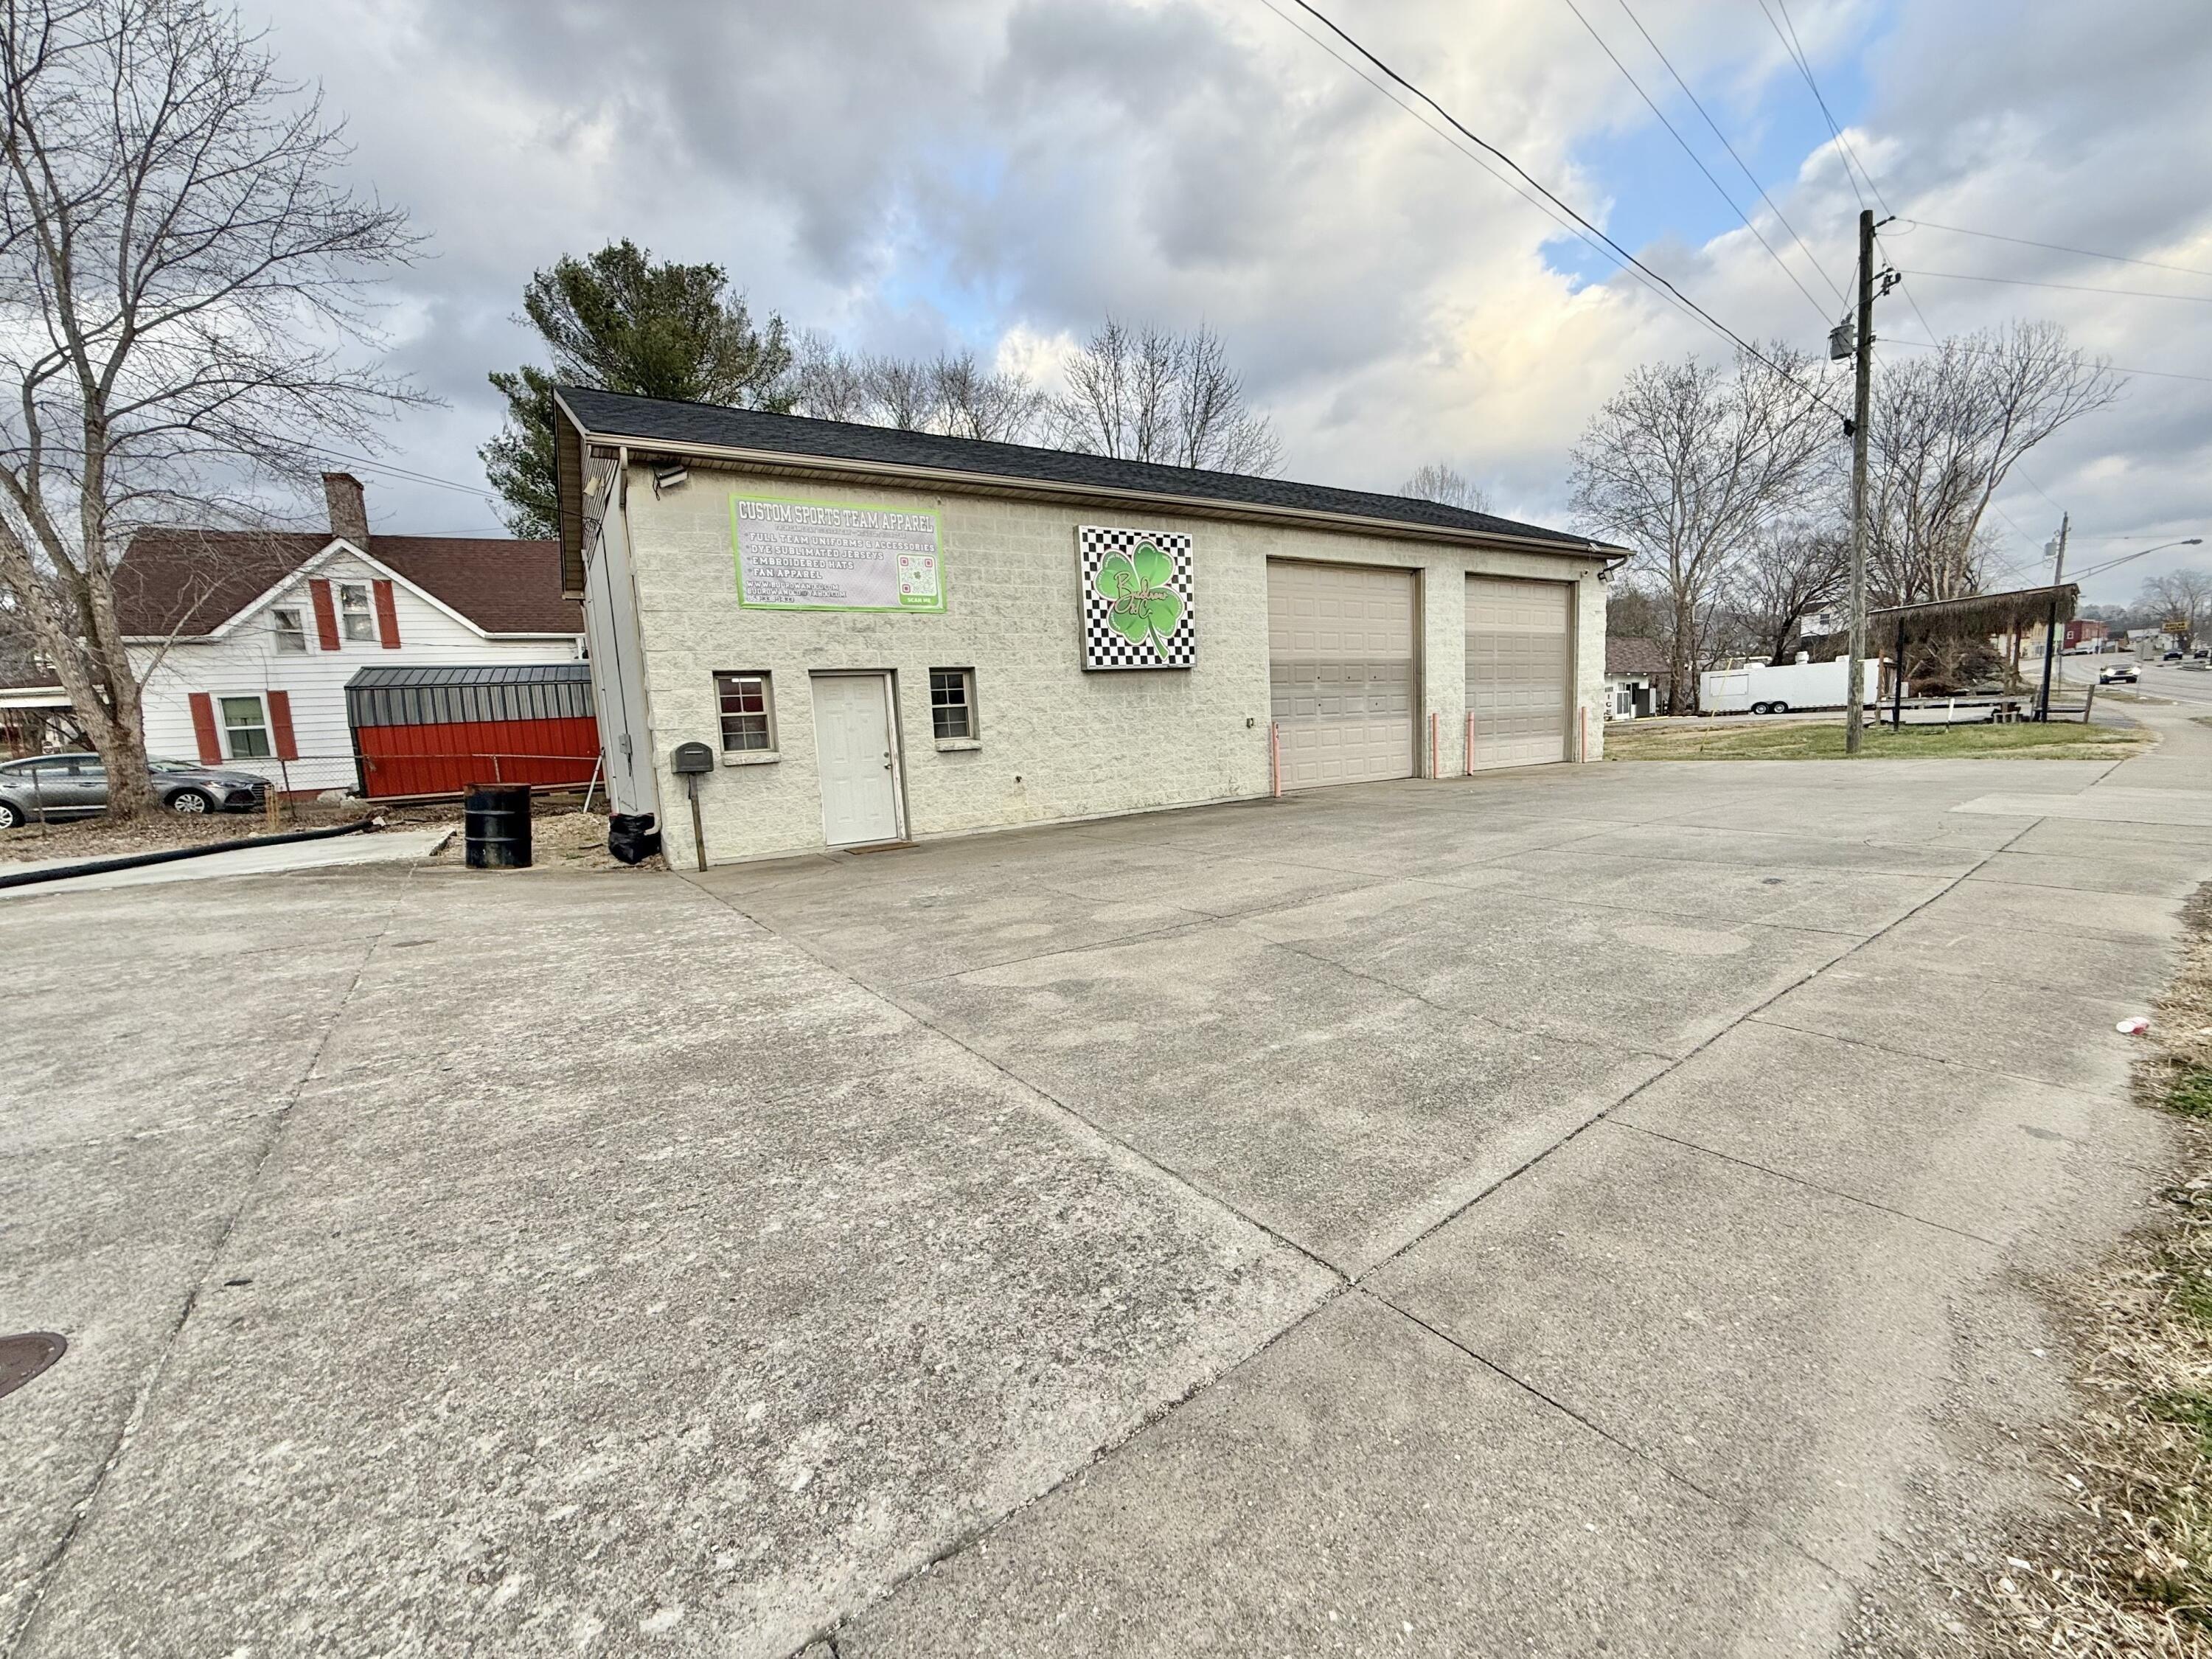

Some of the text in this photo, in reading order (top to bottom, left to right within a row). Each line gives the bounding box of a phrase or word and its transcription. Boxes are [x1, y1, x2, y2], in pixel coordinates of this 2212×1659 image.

[739, 501, 793, 523] CUSTOM
[794, 506, 841, 526] SPORTS
[843, 509, 880, 529] TEAM
[882, 513, 934, 532] APPAREL
[749, 532, 777, 542] FULL
[779, 535, 809, 544] TEAM
[812, 537, 863, 547] UNIFORMS
[875, 541, 936, 552] ACCESSORIES
[751, 545, 884, 560] DYE SUBLIMATED JERSEYS
[752, 557, 855, 569] EMBROIDERED HATS
[754, 568, 823, 579] FAN APPAREL
